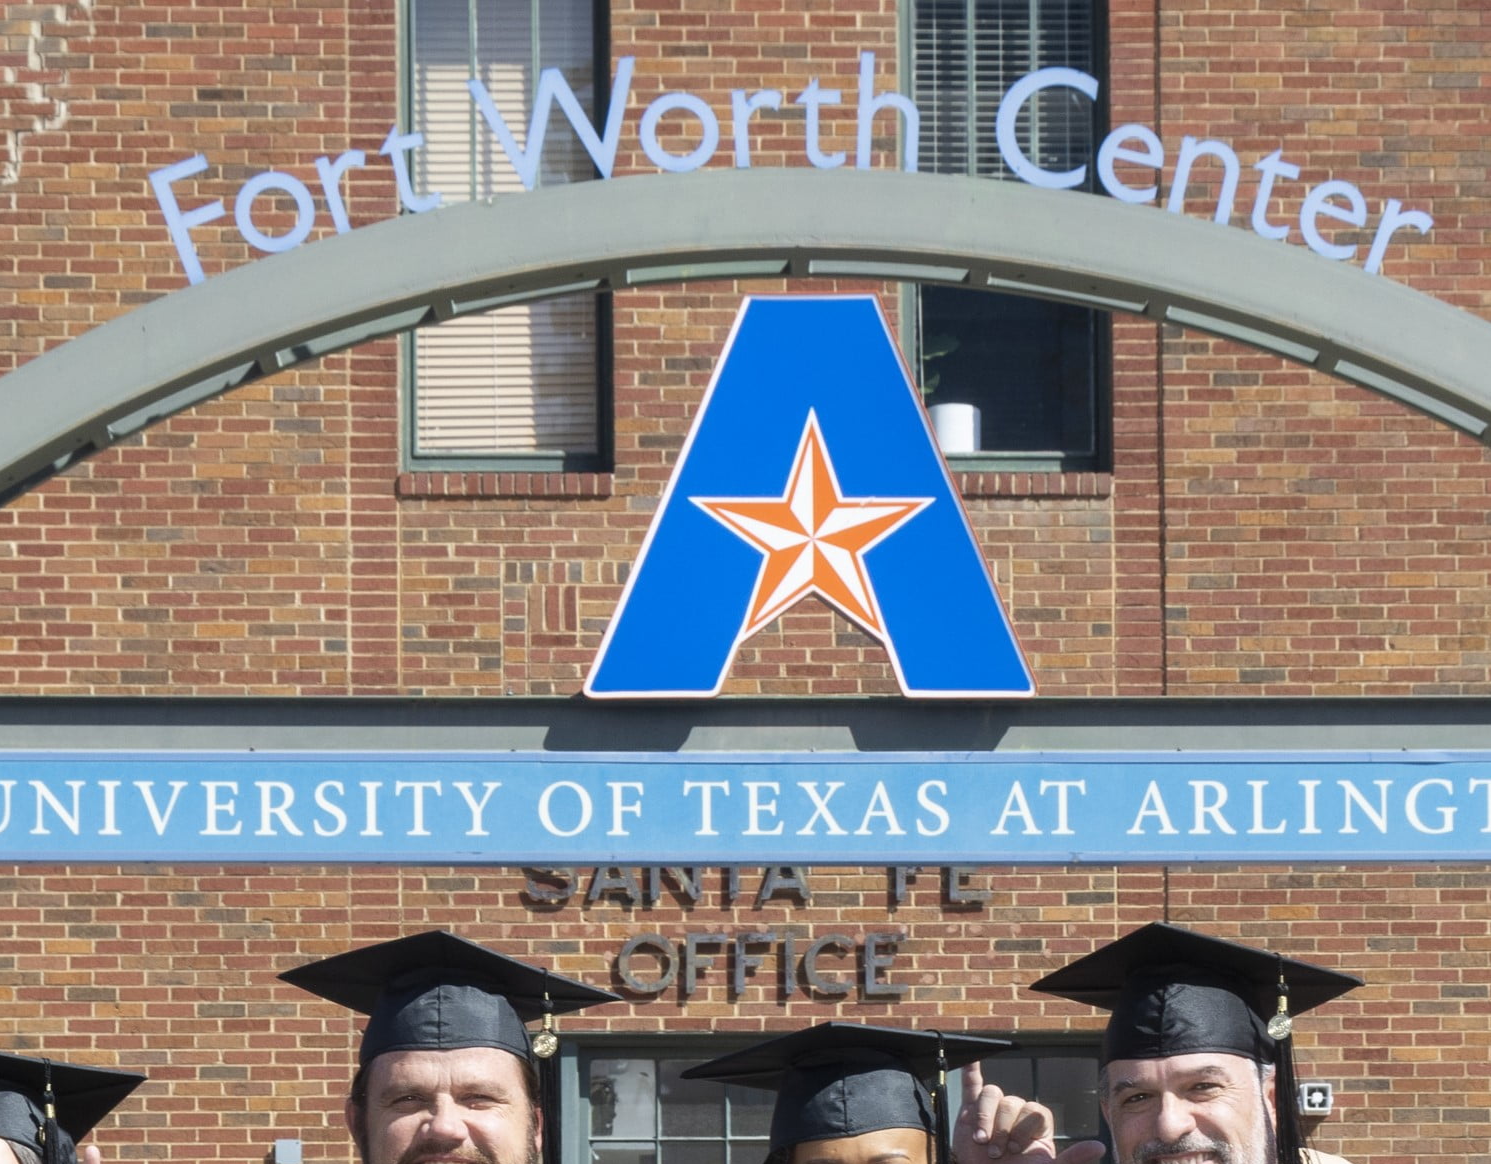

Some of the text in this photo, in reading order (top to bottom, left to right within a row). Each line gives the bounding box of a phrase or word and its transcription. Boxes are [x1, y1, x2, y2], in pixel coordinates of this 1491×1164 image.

[149, 51, 1433, 286] Fort Worth Center
[583, 294, 1036, 698] A
[537, 779, 644, 836] OF
[682, 779, 950, 836] TEXAS
[989, 778, 1086, 835] AT
[618, 931, 908, 996] OFFICE
